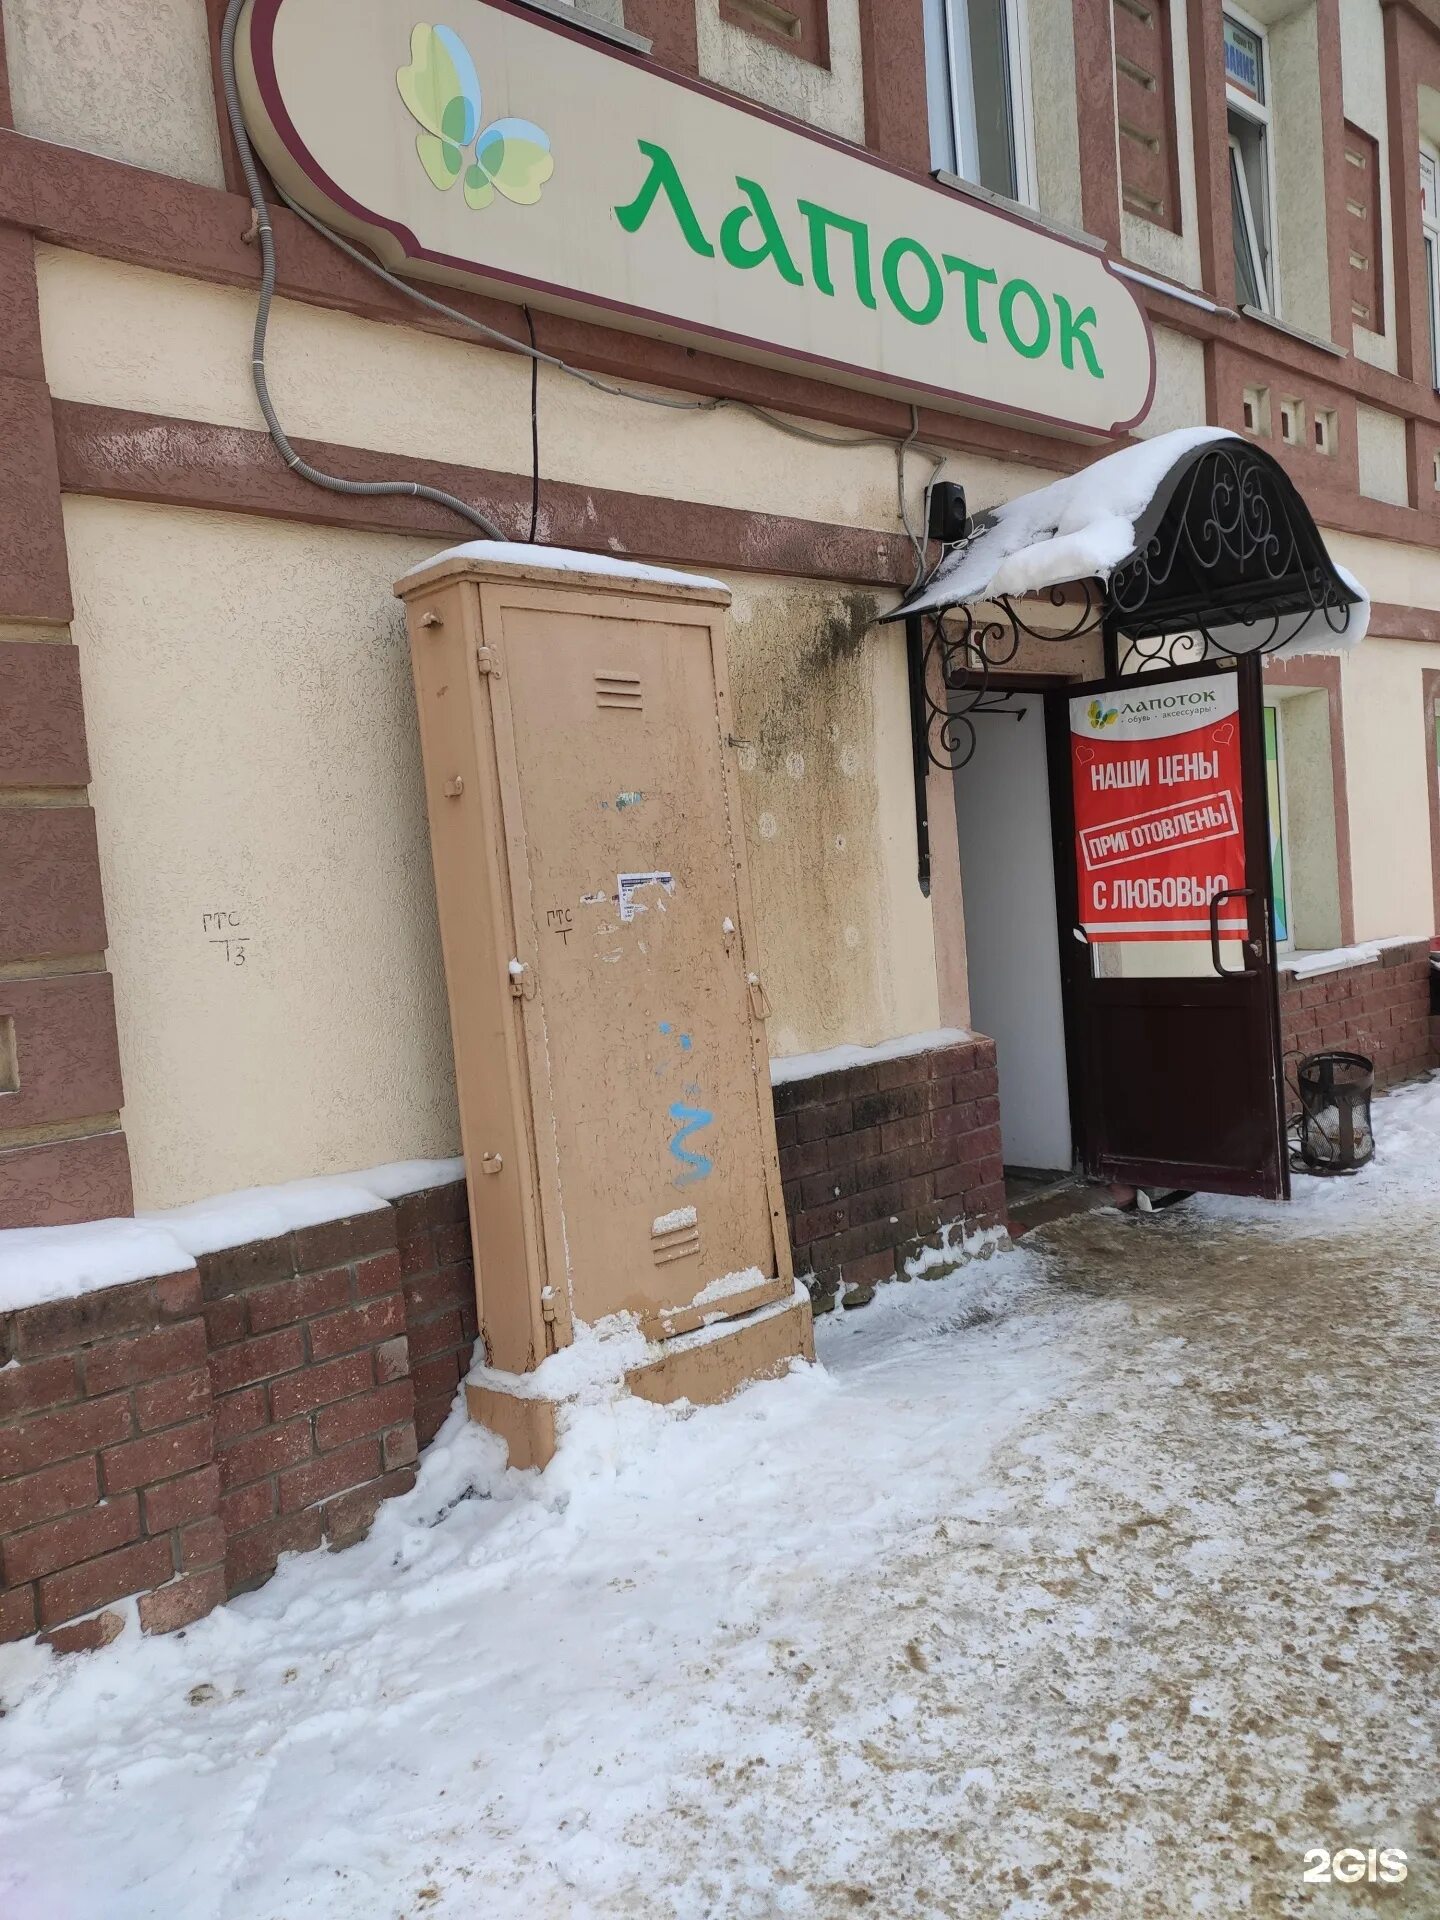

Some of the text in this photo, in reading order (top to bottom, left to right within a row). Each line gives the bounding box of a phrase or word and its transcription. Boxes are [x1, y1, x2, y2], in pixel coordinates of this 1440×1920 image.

[1127, 706, 1212, 724] обувь аксессуары
[1090, 750, 1219, 791] НАШИ ЦЕНЫ
[1088, 803, 1228, 859] ПРИГОТОВЛЕНЫ
[1092, 874, 1229, 911] С ЛЮБОВЬЮ
